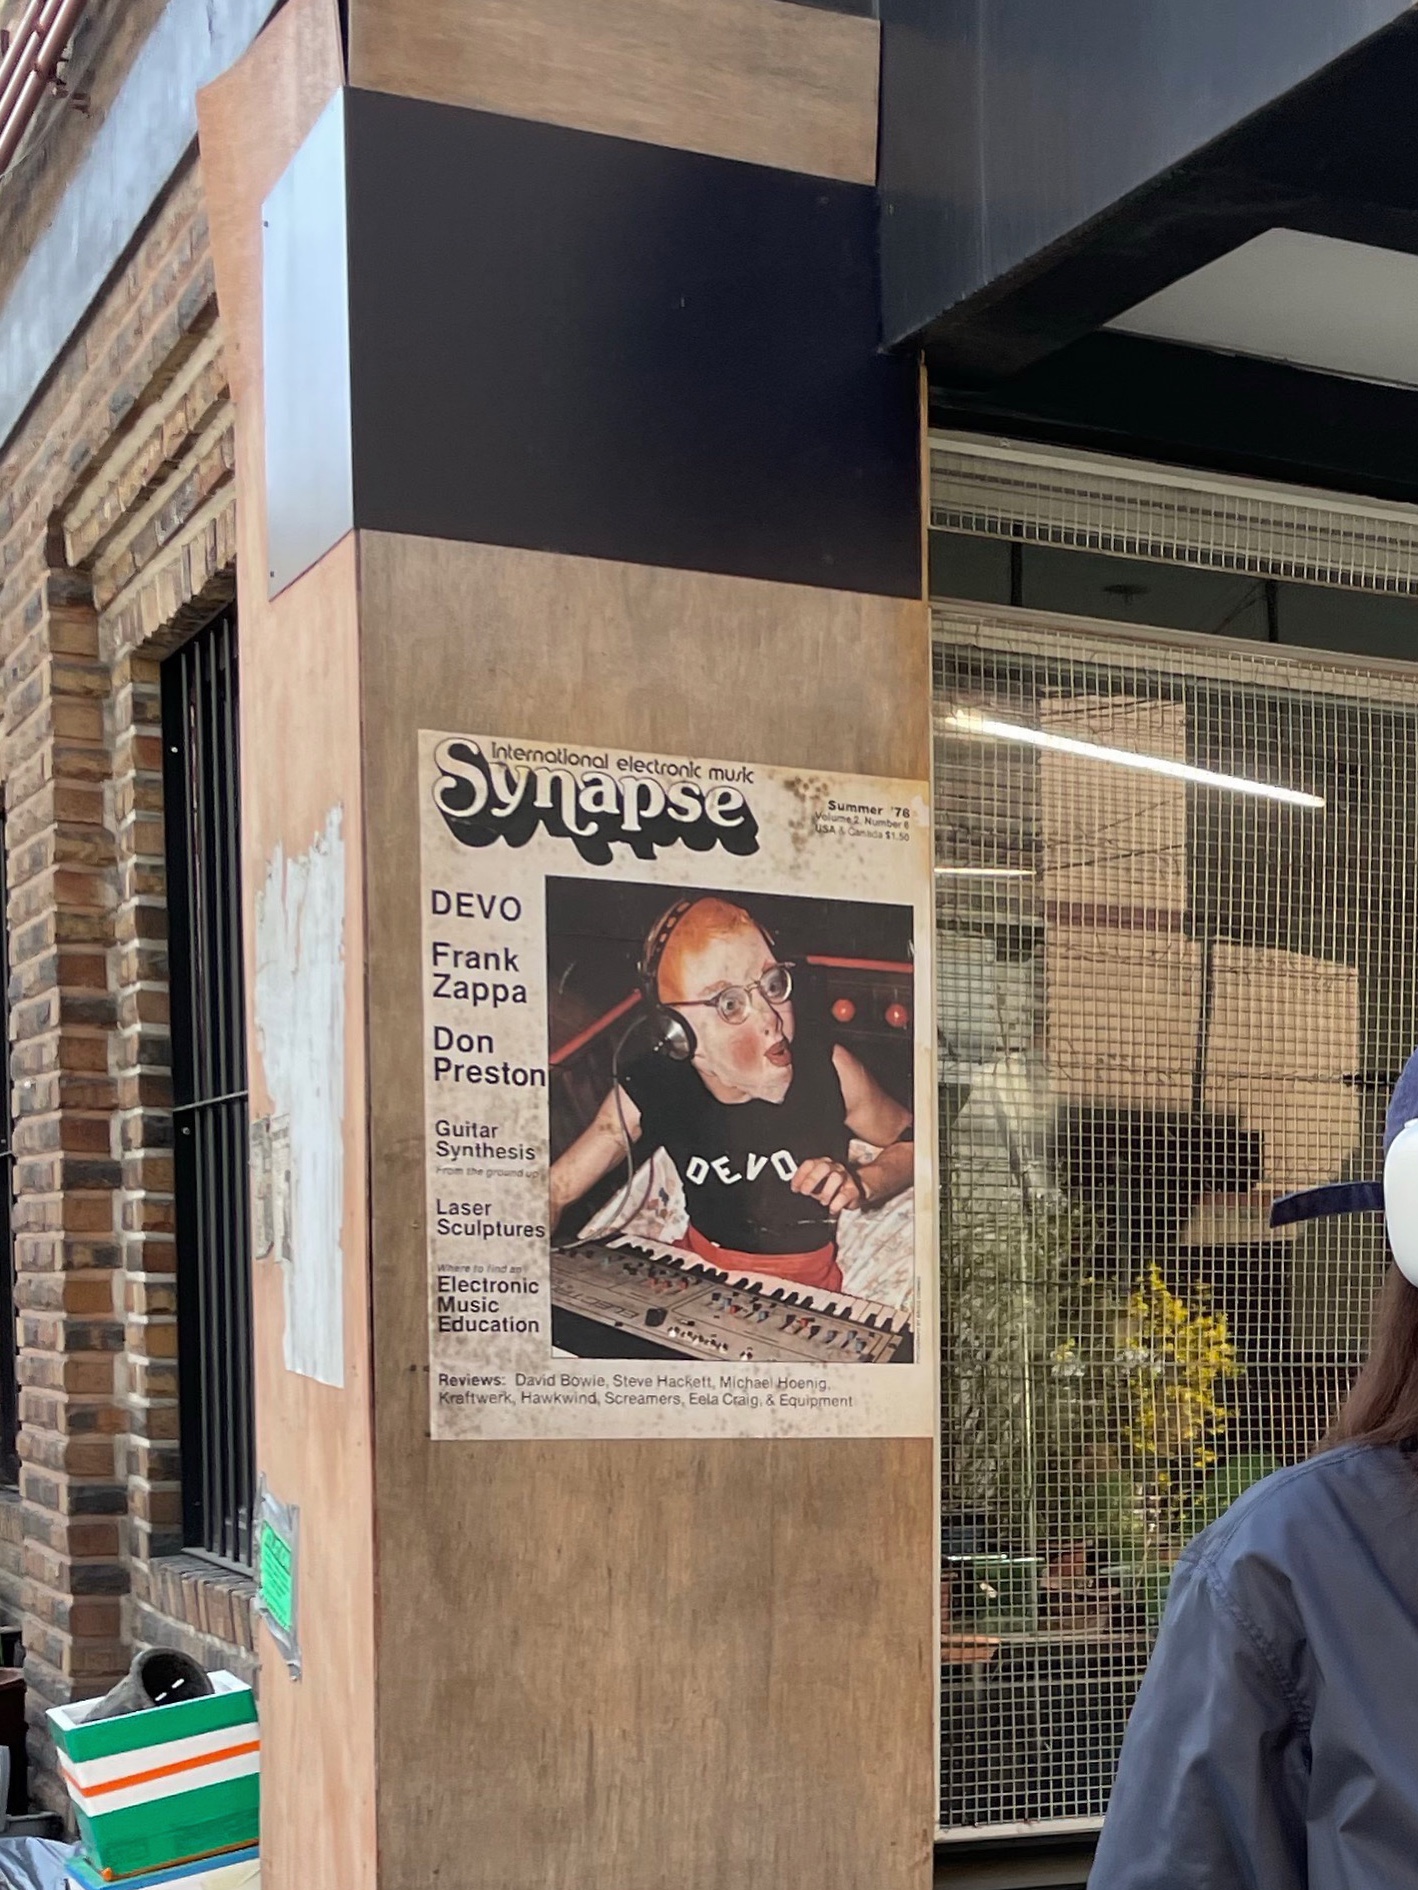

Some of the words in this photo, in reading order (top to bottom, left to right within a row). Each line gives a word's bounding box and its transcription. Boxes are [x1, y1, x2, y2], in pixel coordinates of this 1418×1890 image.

[491, 741, 609, 769] International
[617, 756, 701, 779] electronic
[708, 765, 755, 784] music
[431, 737, 751, 850] Synapse
[828, 799, 884, 815] Summer
[814, 824, 836, 835] USA
[864, 816, 902, 829] Number
[431, 889, 522, 922] DEVO
[432, 941, 520, 972] Frank
[433, 973, 528, 1008] Zappa
[433, 1025, 494, 1054] Don
[434, 1056, 546, 1087] Preston
[435, 1119, 499, 1138] Guitar
[436, 1140, 536, 1161] Synthesis
[467, 1167, 483, 1176] the
[486, 1168, 524, 1179] ground
[686, 1149, 799, 1185] DEVO
[436, 1198, 492, 1216] Laser
[437, 1218, 545, 1240] Sculptures
[437, 1263, 471, 1273] Where
[473, 1264, 484, 1274] to
[486, 1264, 508, 1274] find
[438, 1275, 540, 1294] Electronic
[438, 1295, 500, 1313] Music
[438, 1315, 540, 1333] Education
[438, 1373, 506, 1387] Reviews:
[515, 1373, 556, 1387] David
[560, 1374, 610, 1389] Bowie,
[613, 1374, 653, 1388] Steve
[657, 1375, 716, 1390] Hackett,
[719, 1376, 774, 1390] Michael
[438, 1391, 517, 1406] Kraftwerk,
[520, 1391, 601, 1406] Hawkwind,
[604, 1391, 686, 1407] Screamers,
[689, 1392, 719, 1406] Eela
[765, 1394, 776, 1406] &
[779, 1394, 854, 1409] Equipment
